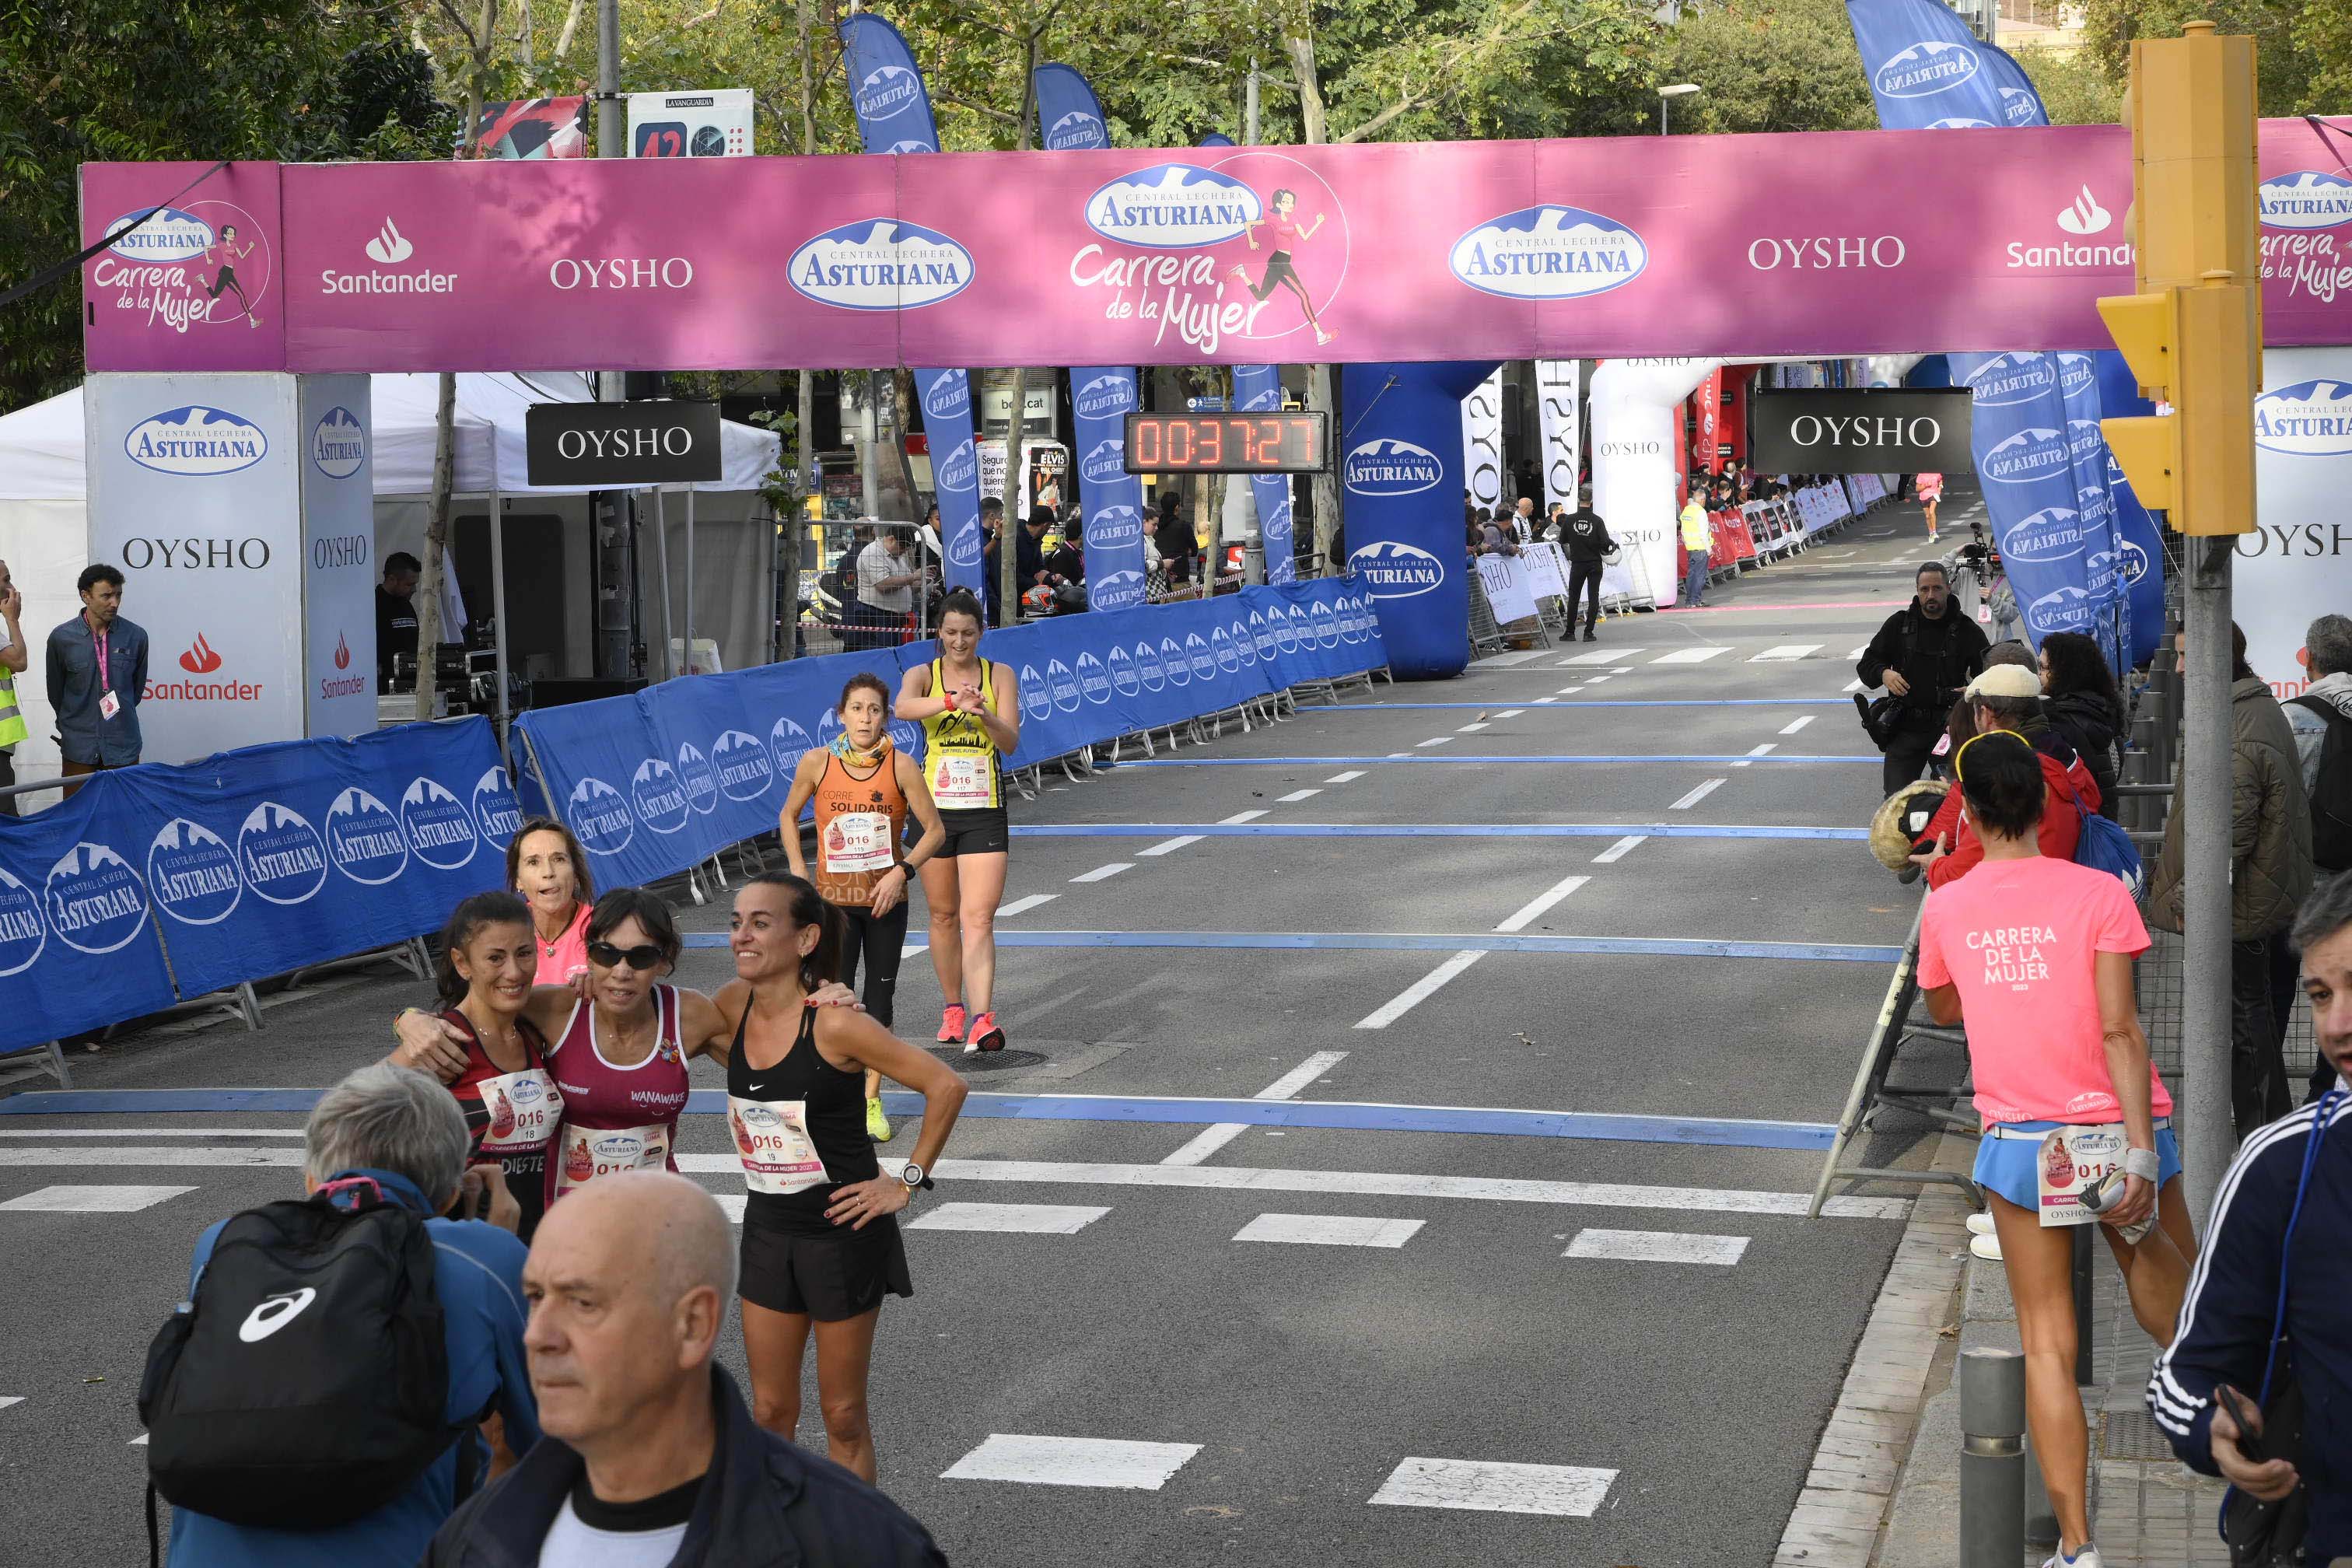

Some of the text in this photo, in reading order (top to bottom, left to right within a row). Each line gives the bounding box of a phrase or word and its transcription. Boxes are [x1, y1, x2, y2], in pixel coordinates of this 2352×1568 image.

[1125, 192, 1244, 201] CENTRAL LECHERA
[1098, 198, 1246, 226] ASTURIANA
[1496, 236, 1626, 247] CENTRAL LECHERA
[1748, 235, 1906, 270] OYSHO
[2260, 233, 2334, 256] arrera
[830, 248, 954, 259] CENTRAL LECHERA
[1069, 243, 1216, 287] Carrera
[1465, 241, 1632, 276] ASTURIANA
[2007, 241, 2137, 268] Santand
[94, 258, 186, 288] Carrera
[549, 257, 694, 289] OYSHO
[801, 253, 961, 286] ASTURIANA
[2278, 251, 2352, 303] la Muje
[322, 269, 459, 294] Santander
[117, 285, 221, 334] de la Mujer
[1105, 280, 1269, 355] de la Mujer
[158, 429, 253, 438] CENTRAL LECHERA
[1790, 415, 1941, 448] OYSHO
[2255, 409, 2352, 437] ASTURIA
[136, 431, 258, 459] ASTURIANA
[317, 432, 362, 462] ASTURIANA
[557, 426, 692, 459] OYSHO
[1138, 421, 1313, 464] 00:37:27
[1601, 441, 1660, 457] OYSHO
[1041, 453, 1065, 464] ELVIS
[982, 467, 996, 475] que
[1348, 461, 1436, 484] ASTURIANA
[1577, 523, 1589, 531] BP
[314, 534, 367, 569] OYSHO
[2233, 523, 2352, 558] OYSH
[122, 537, 271, 569] OYSHO
[141, 678, 263, 701] Santander
[321, 677, 365, 699] Santander
[823, 790, 853, 801] CORRE
[830, 802, 893, 814] SOLIDARIS
[481, 803, 524, 837] ASTUR
[254, 831, 312, 850] CENTRAL LECHERA
[408, 815, 474, 849] ASTURIANA
[847, 835, 870, 845] 016
[333, 828, 405, 865] ASTURIANA
[166, 849, 226, 869] CENTRAL LECHERA
[247, 845, 324, 884] ASTURIANA
[63, 878, 96, 896] CENTRAL
[158, 863, 238, 904] ASTURIANA
[0, 894, 27, 906] ECHERA
[1965, 926, 2057, 950] CARRERA
[1984, 944, 2043, 966] DE LA
[1984, 963, 2050, 985] MUJER
[631, 1090, 685, 1105] WANAWAKE
[517, 1110, 544, 1128] 016
[525, 1129, 535, 1139] 18
[752, 1135, 782, 1149] 016
[597, 1144, 639, 1153] ASTURIANA
[767, 1153, 776, 1161] 19
[597, 1164, 635, 1175] 01
[786, 1177, 819, 1185] Santander
[2051, 1209, 2087, 1219] OYSHO
